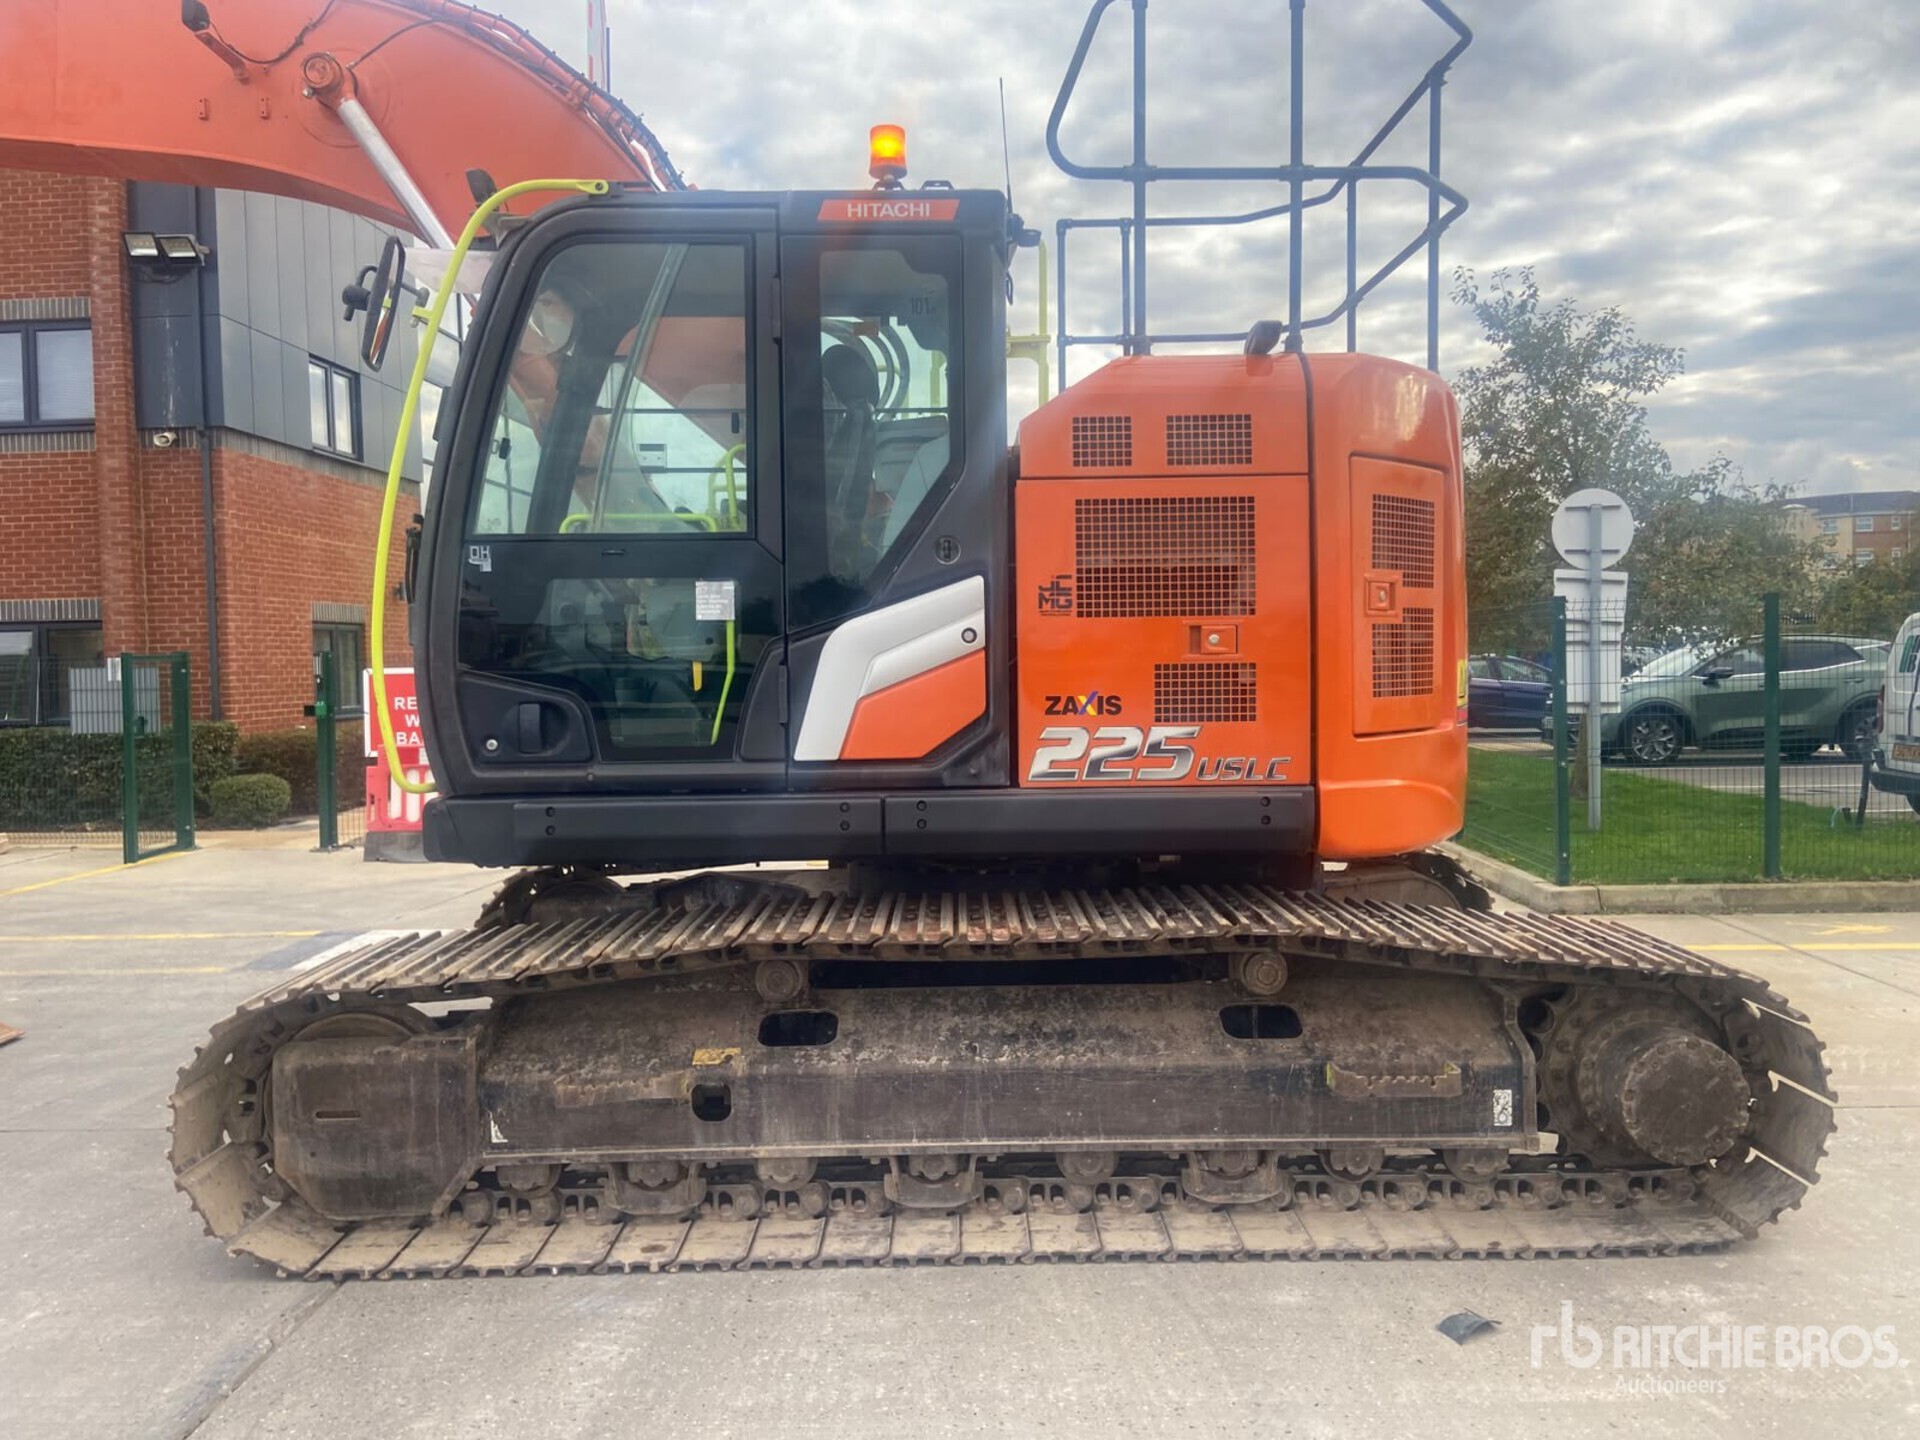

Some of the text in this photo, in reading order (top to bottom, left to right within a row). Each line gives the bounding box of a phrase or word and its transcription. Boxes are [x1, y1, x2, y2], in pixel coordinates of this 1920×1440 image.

[847, 202, 930, 218] HITACHI
[1045, 691, 1122, 716] ZAXIS
[396, 732, 424, 745] BA
[1028, 726, 1292, 782] 225 USLC
